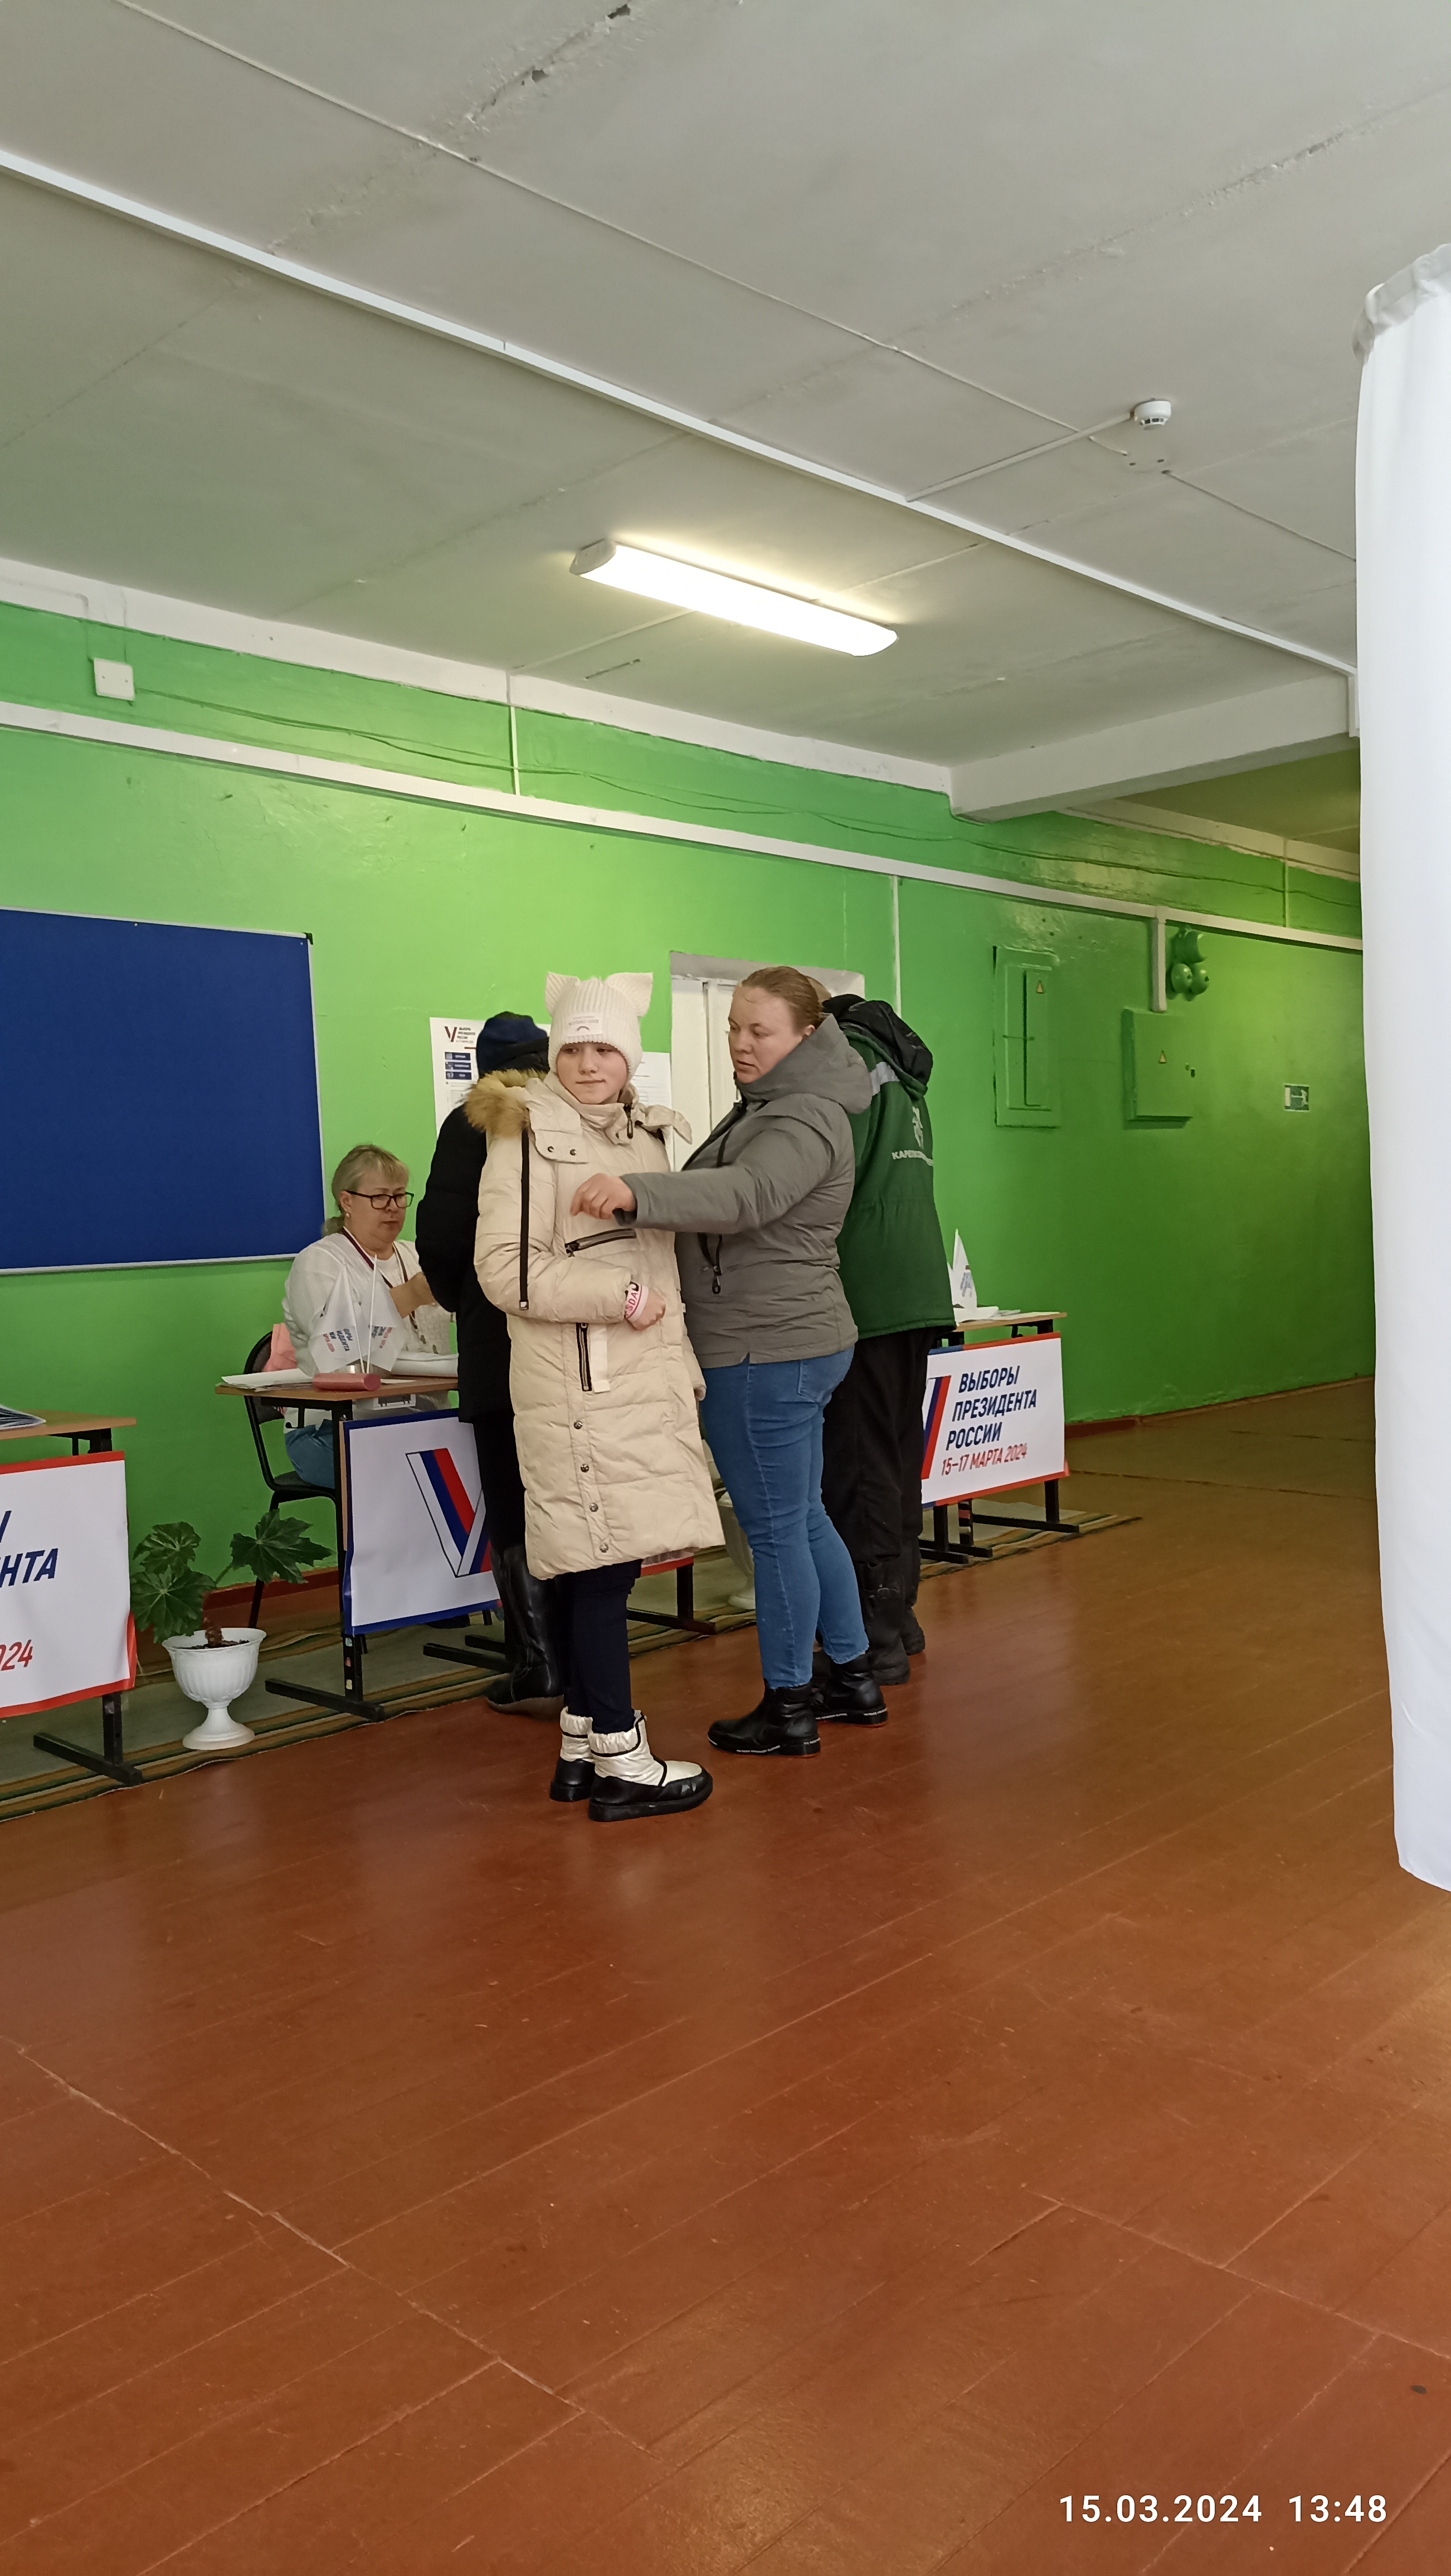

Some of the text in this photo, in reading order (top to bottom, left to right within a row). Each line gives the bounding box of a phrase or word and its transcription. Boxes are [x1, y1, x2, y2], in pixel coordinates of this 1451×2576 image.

[958, 1365, 1020, 1393] ВЫБОРЫ
[952, 1389, 1036, 1422] ПРЕЗИДЕНТА
[946, 1422, 1002, 1451] РОССИИ
[970, 1447, 1003, 1470] МАРТА
[1004, 1442, 1028, 1462] 2024
[0, 1548, 58, 1588] НТА
